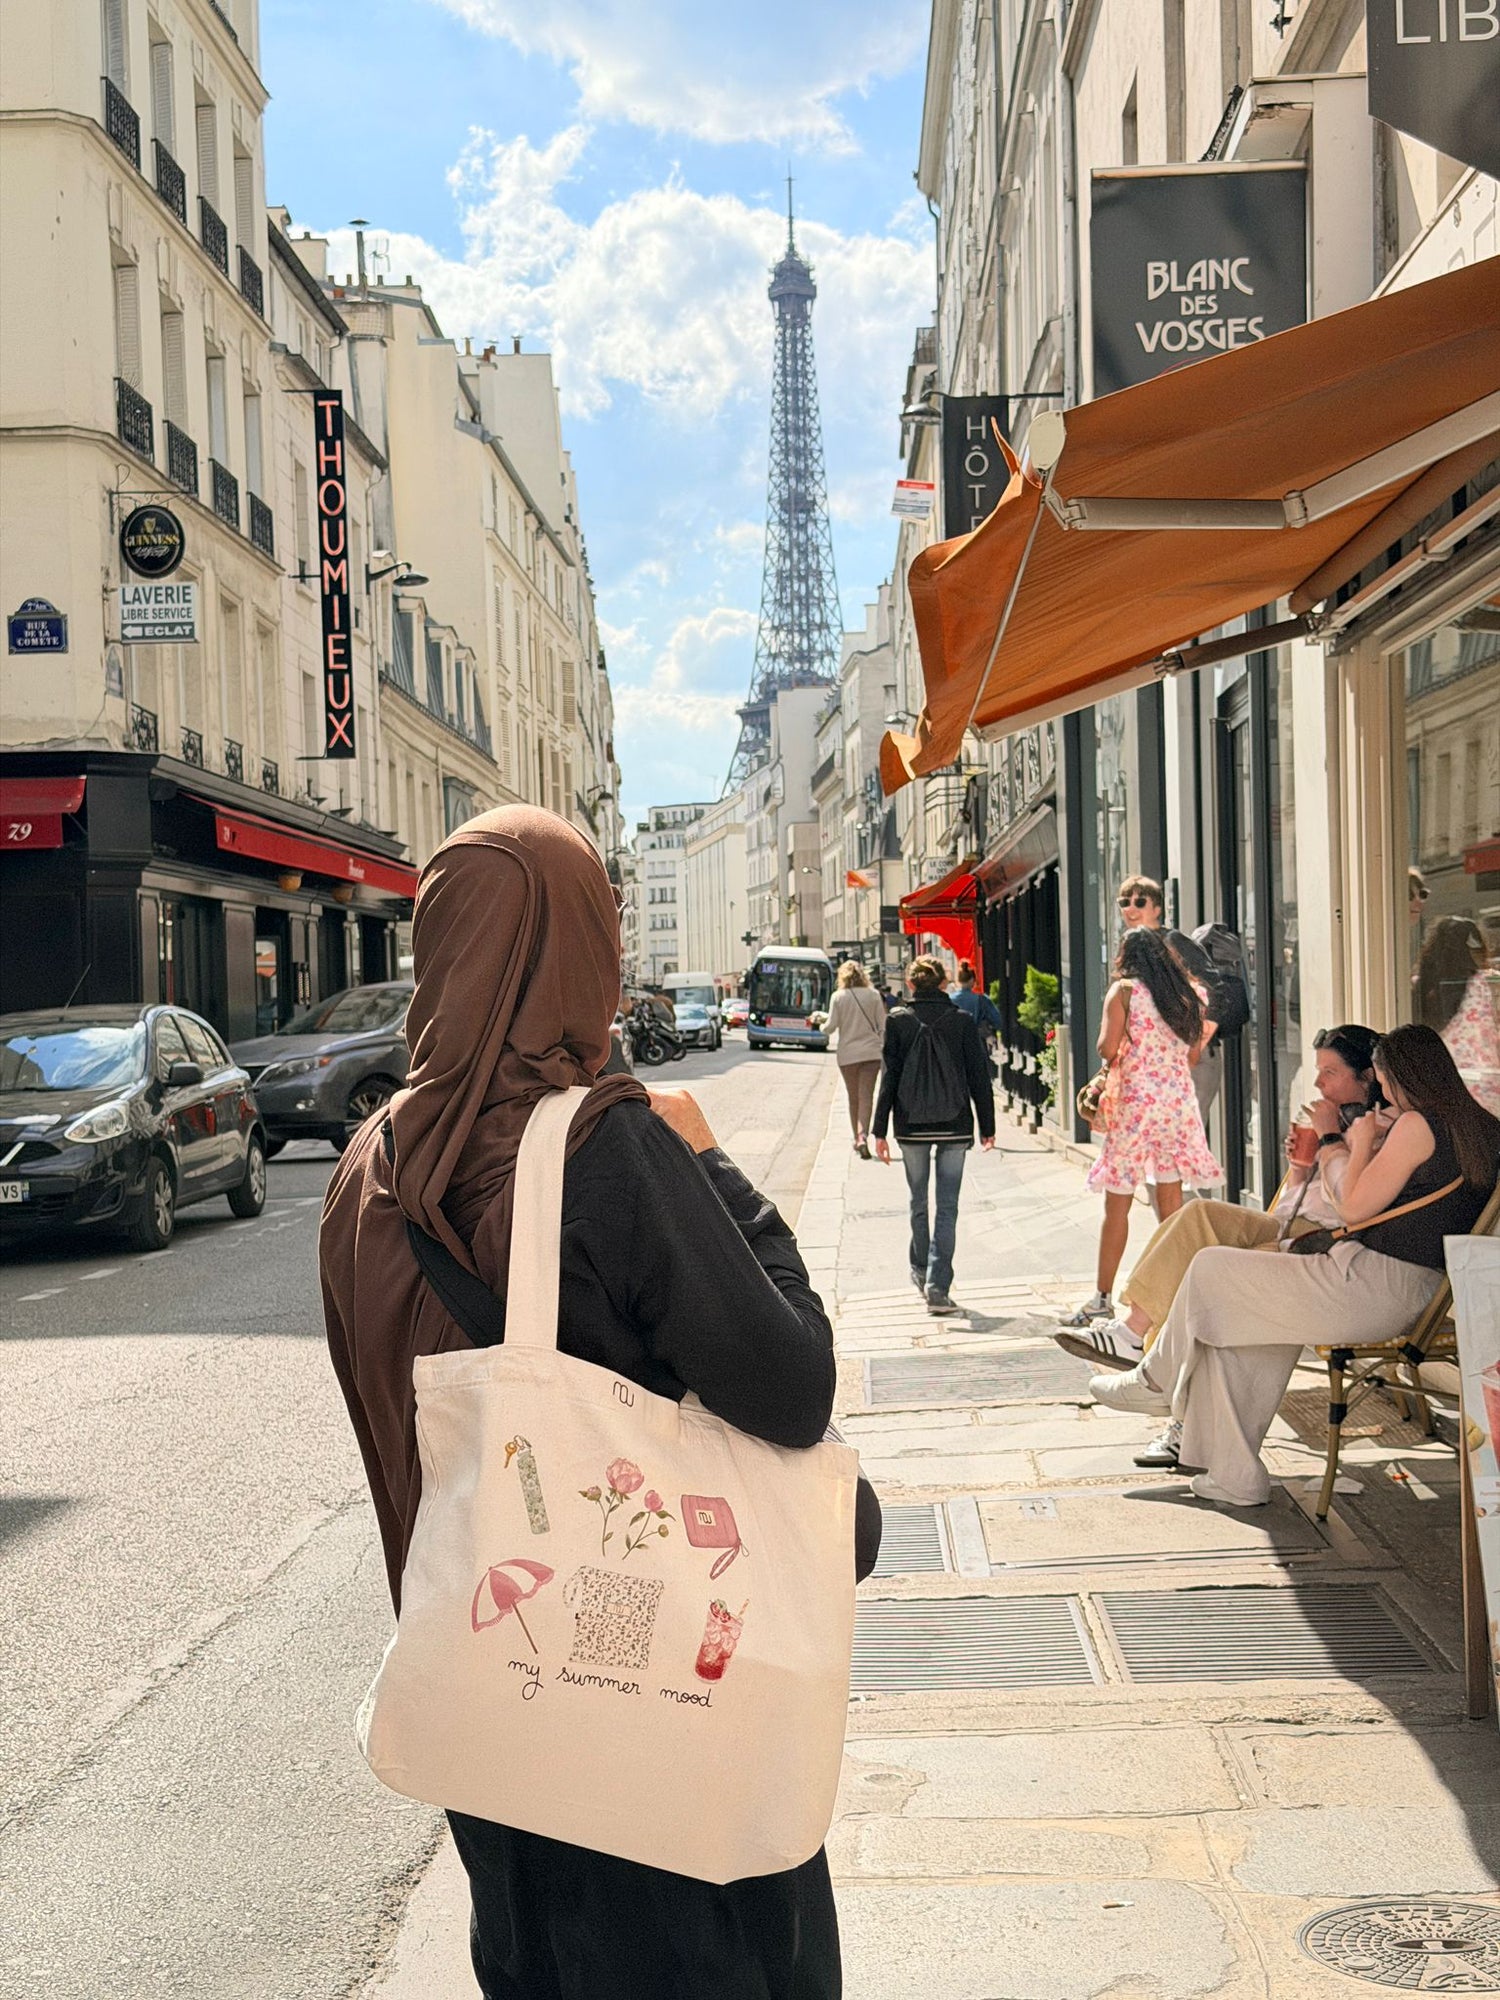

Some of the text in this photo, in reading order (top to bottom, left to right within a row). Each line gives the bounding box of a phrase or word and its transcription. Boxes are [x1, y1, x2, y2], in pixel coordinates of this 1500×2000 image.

[1146, 257, 1254, 301] BLANC
[1180, 294, 1219, 316] DES
[1134, 316, 1266, 353] VOSGES
[124, 533, 179, 548] GUINNESS
[317, 399, 354, 749] THOUMIEUX
[121, 585, 192, 605] LAVERIE
[121, 606, 192, 621] LIBRE SERVICE
[24, 629, 51, 638] DE LA
[26, 620, 48, 630] RUE
[143, 625, 193, 637] ECLAT
[8, 822, 33, 842] 79
[1, 1184, 19, 1199] VS
[507, 1660, 714, 1708] my summer mood
